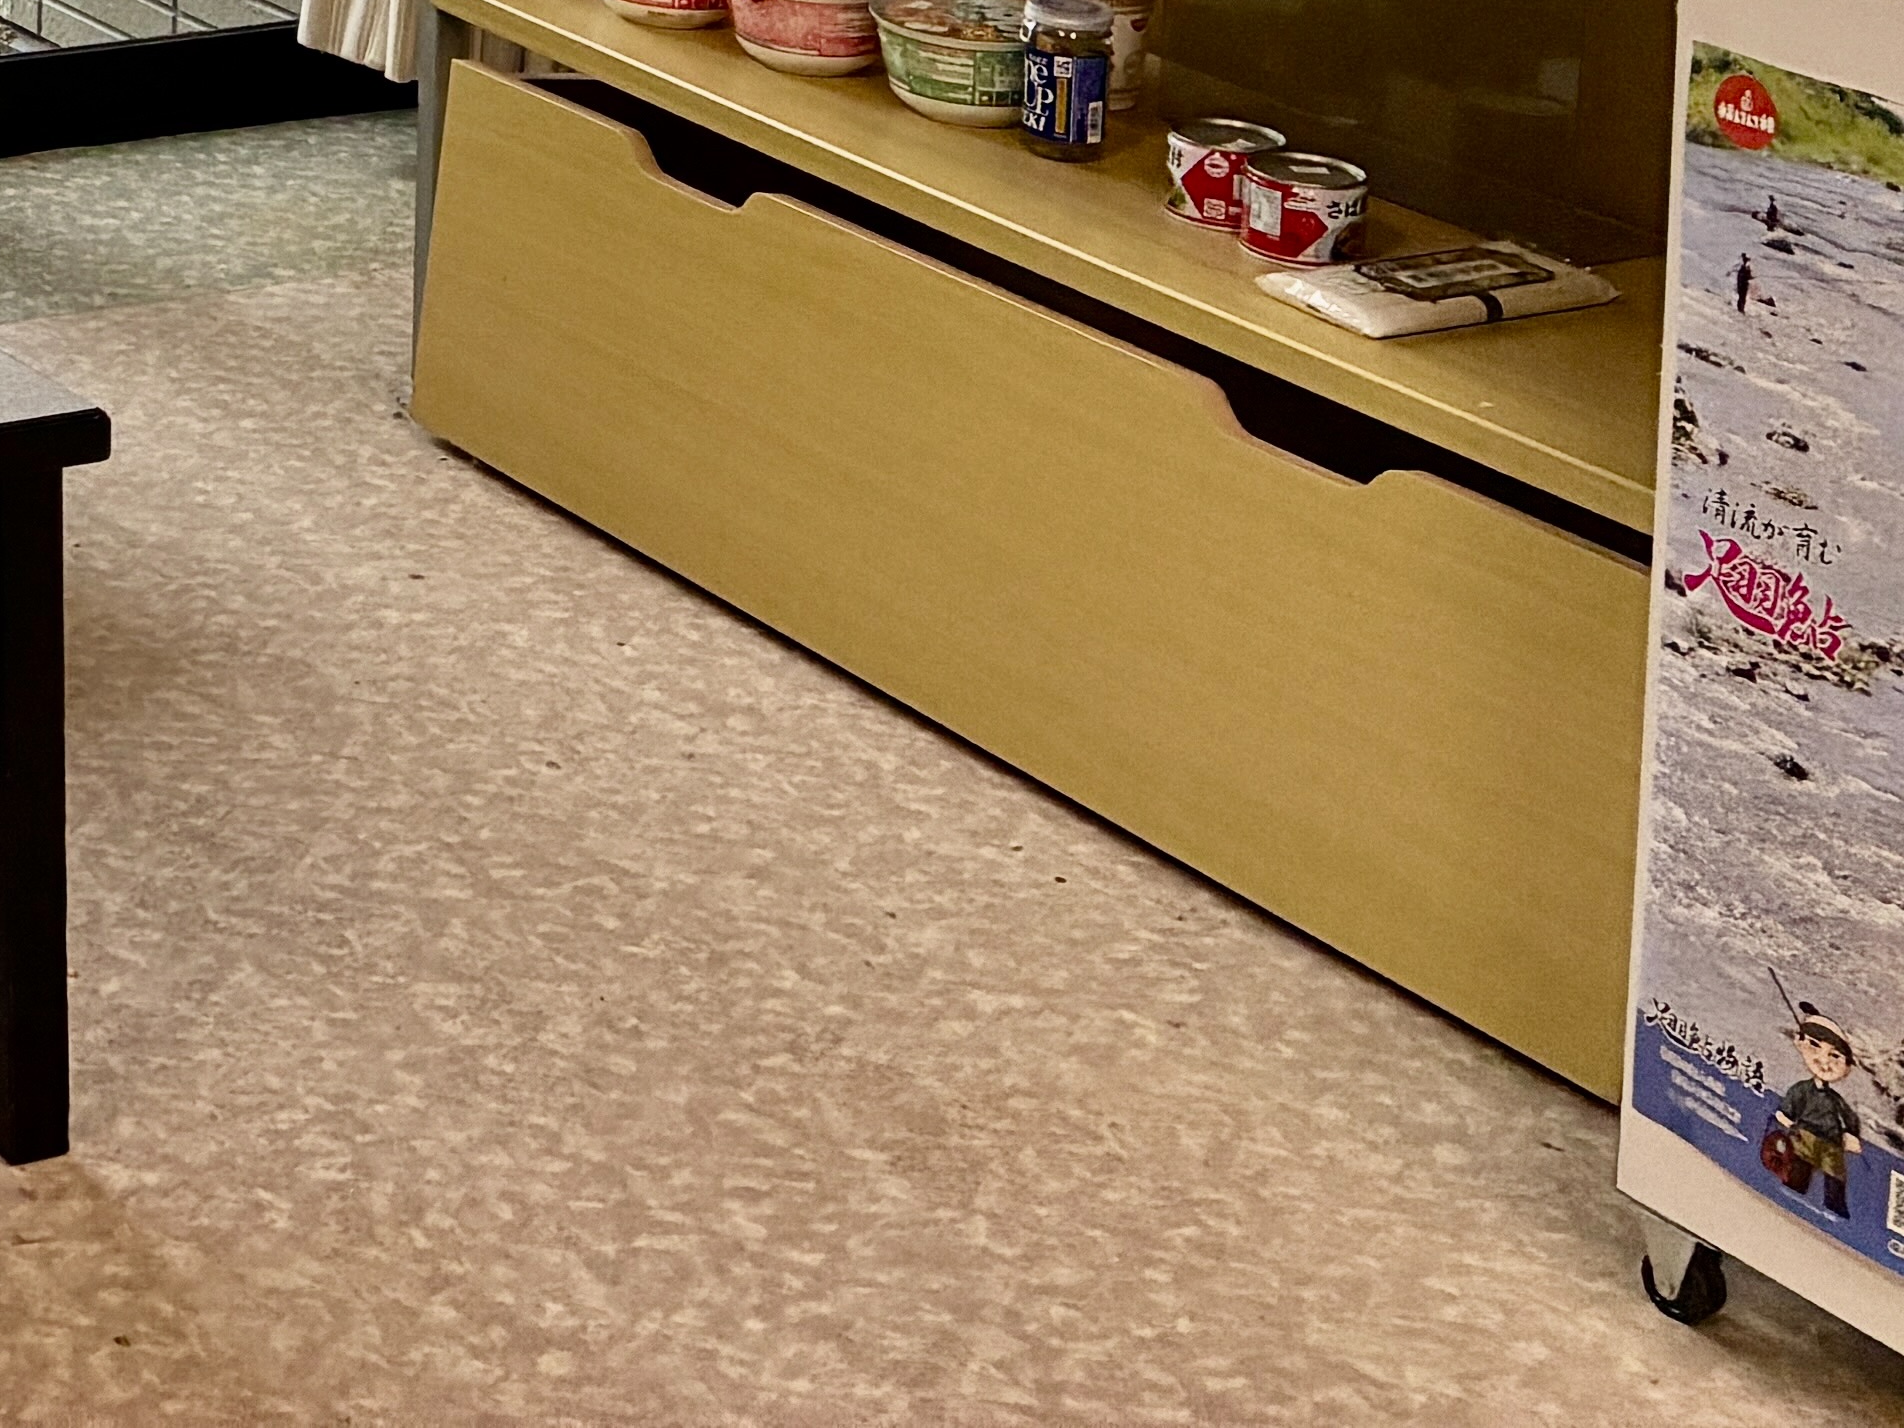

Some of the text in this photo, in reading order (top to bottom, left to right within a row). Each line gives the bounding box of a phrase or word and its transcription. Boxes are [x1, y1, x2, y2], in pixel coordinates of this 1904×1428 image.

[1703, 488, 1842, 565] 清流が育む
